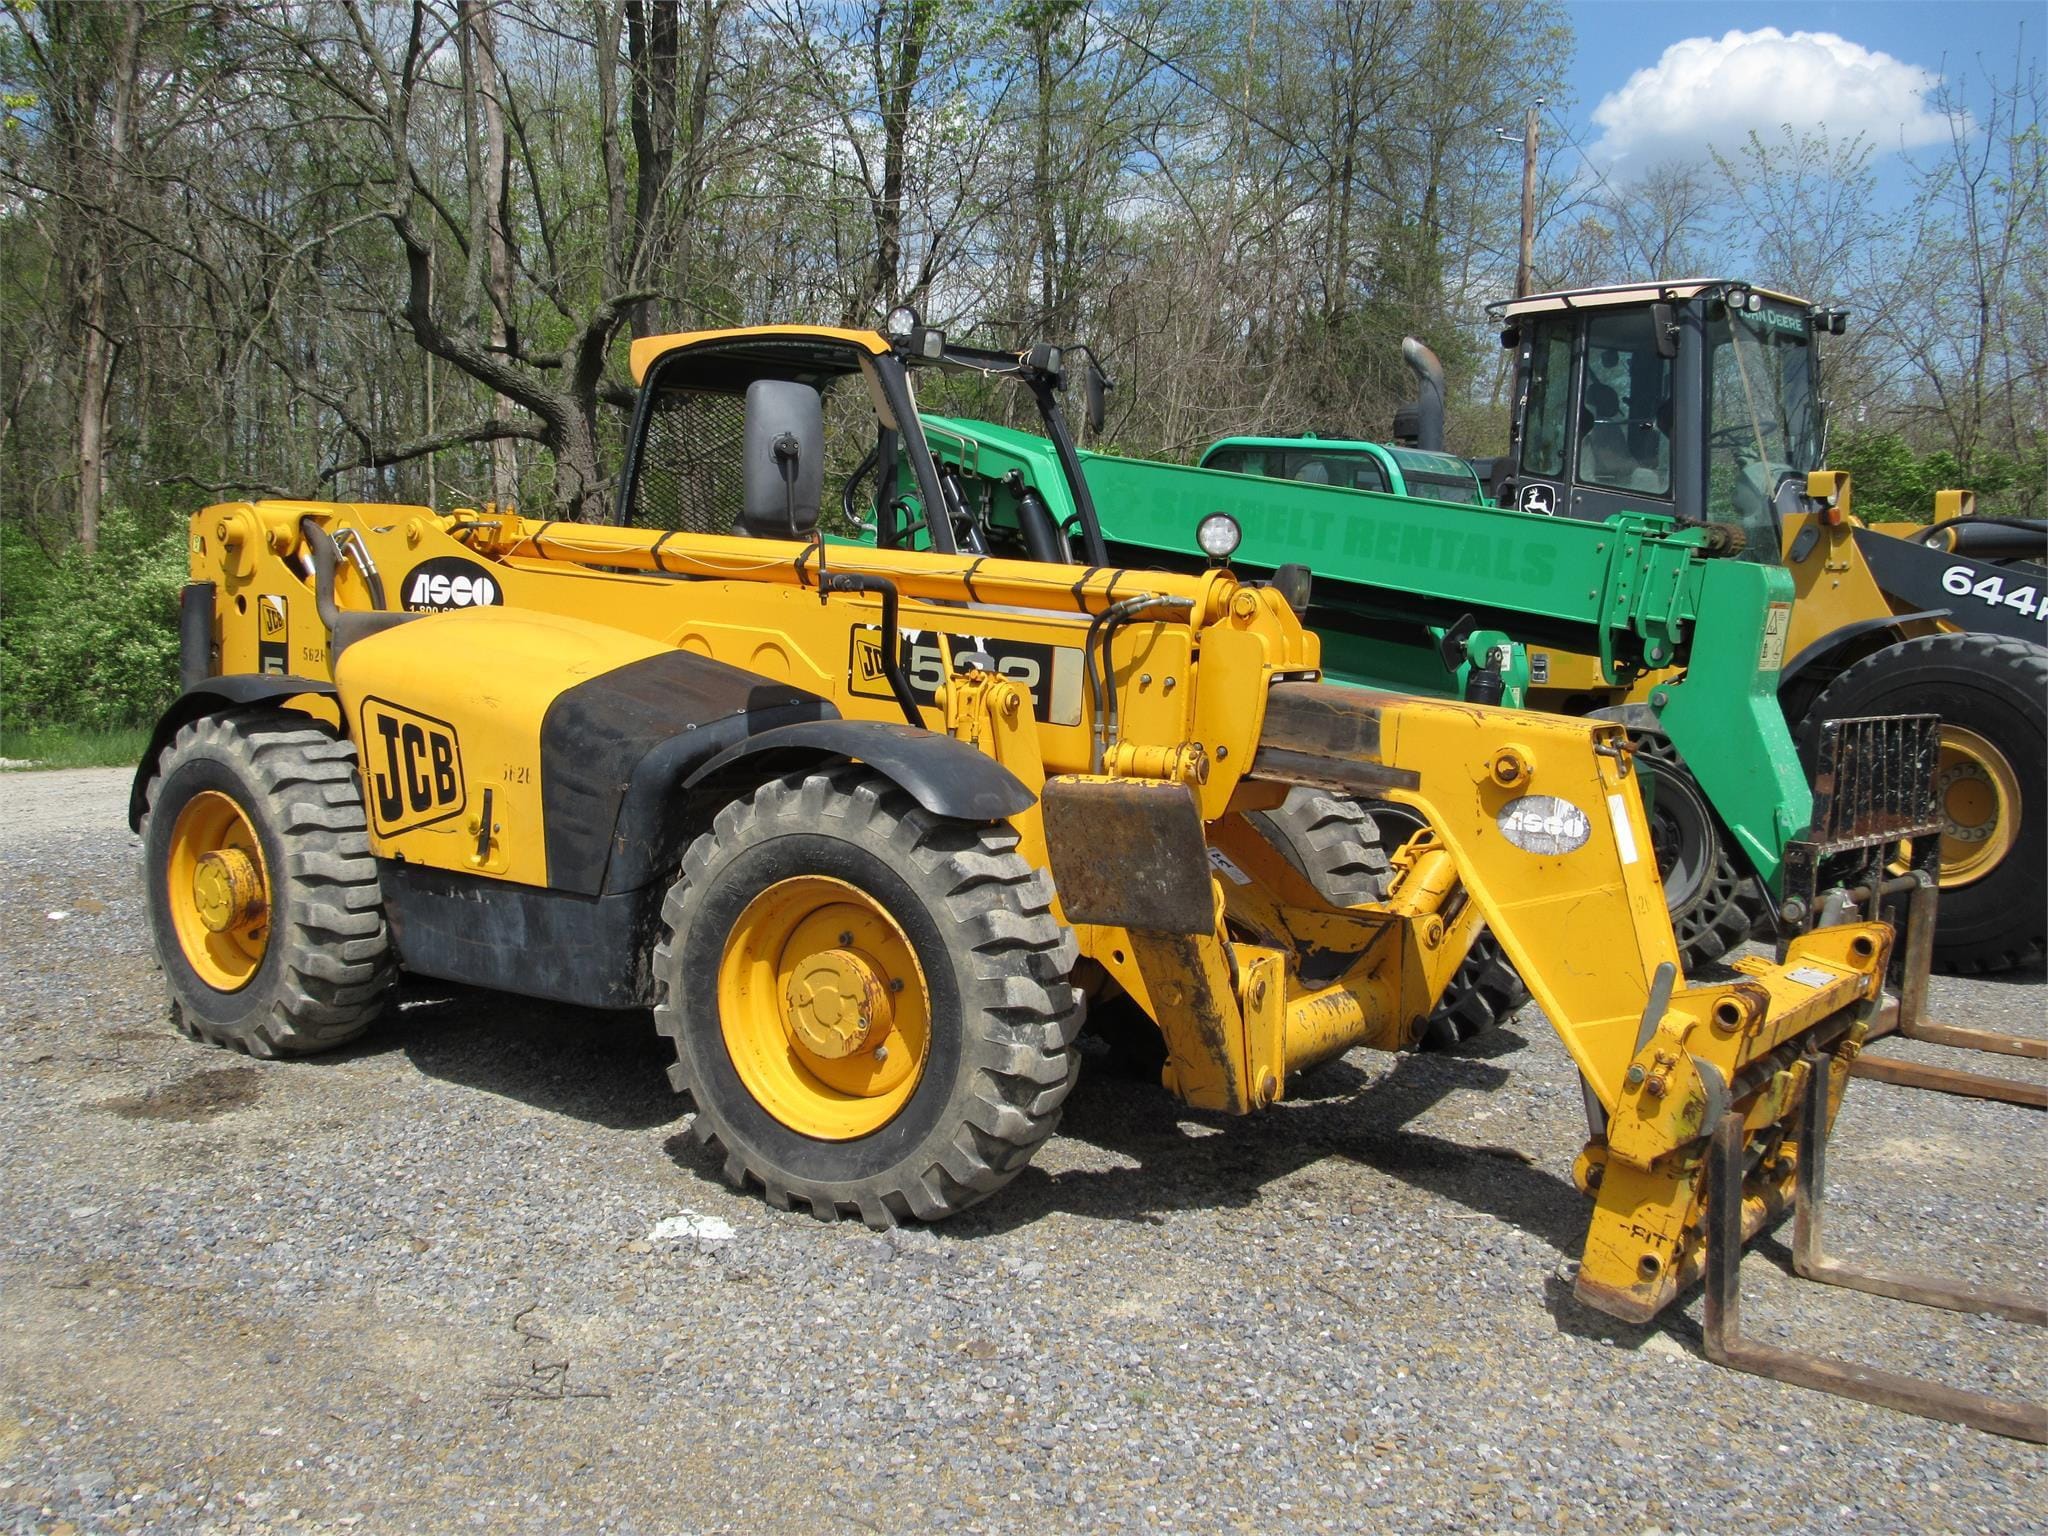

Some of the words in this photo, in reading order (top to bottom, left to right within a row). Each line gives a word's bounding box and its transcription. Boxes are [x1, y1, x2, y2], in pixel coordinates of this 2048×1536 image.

[1768, 310, 1803, 331] DEERE
[1342, 515, 1558, 587] RENTALS
[410, 574, 494, 606] ASCO
[375, 713, 457, 823] JCB
[1502, 811, 1585, 838] ASCO
